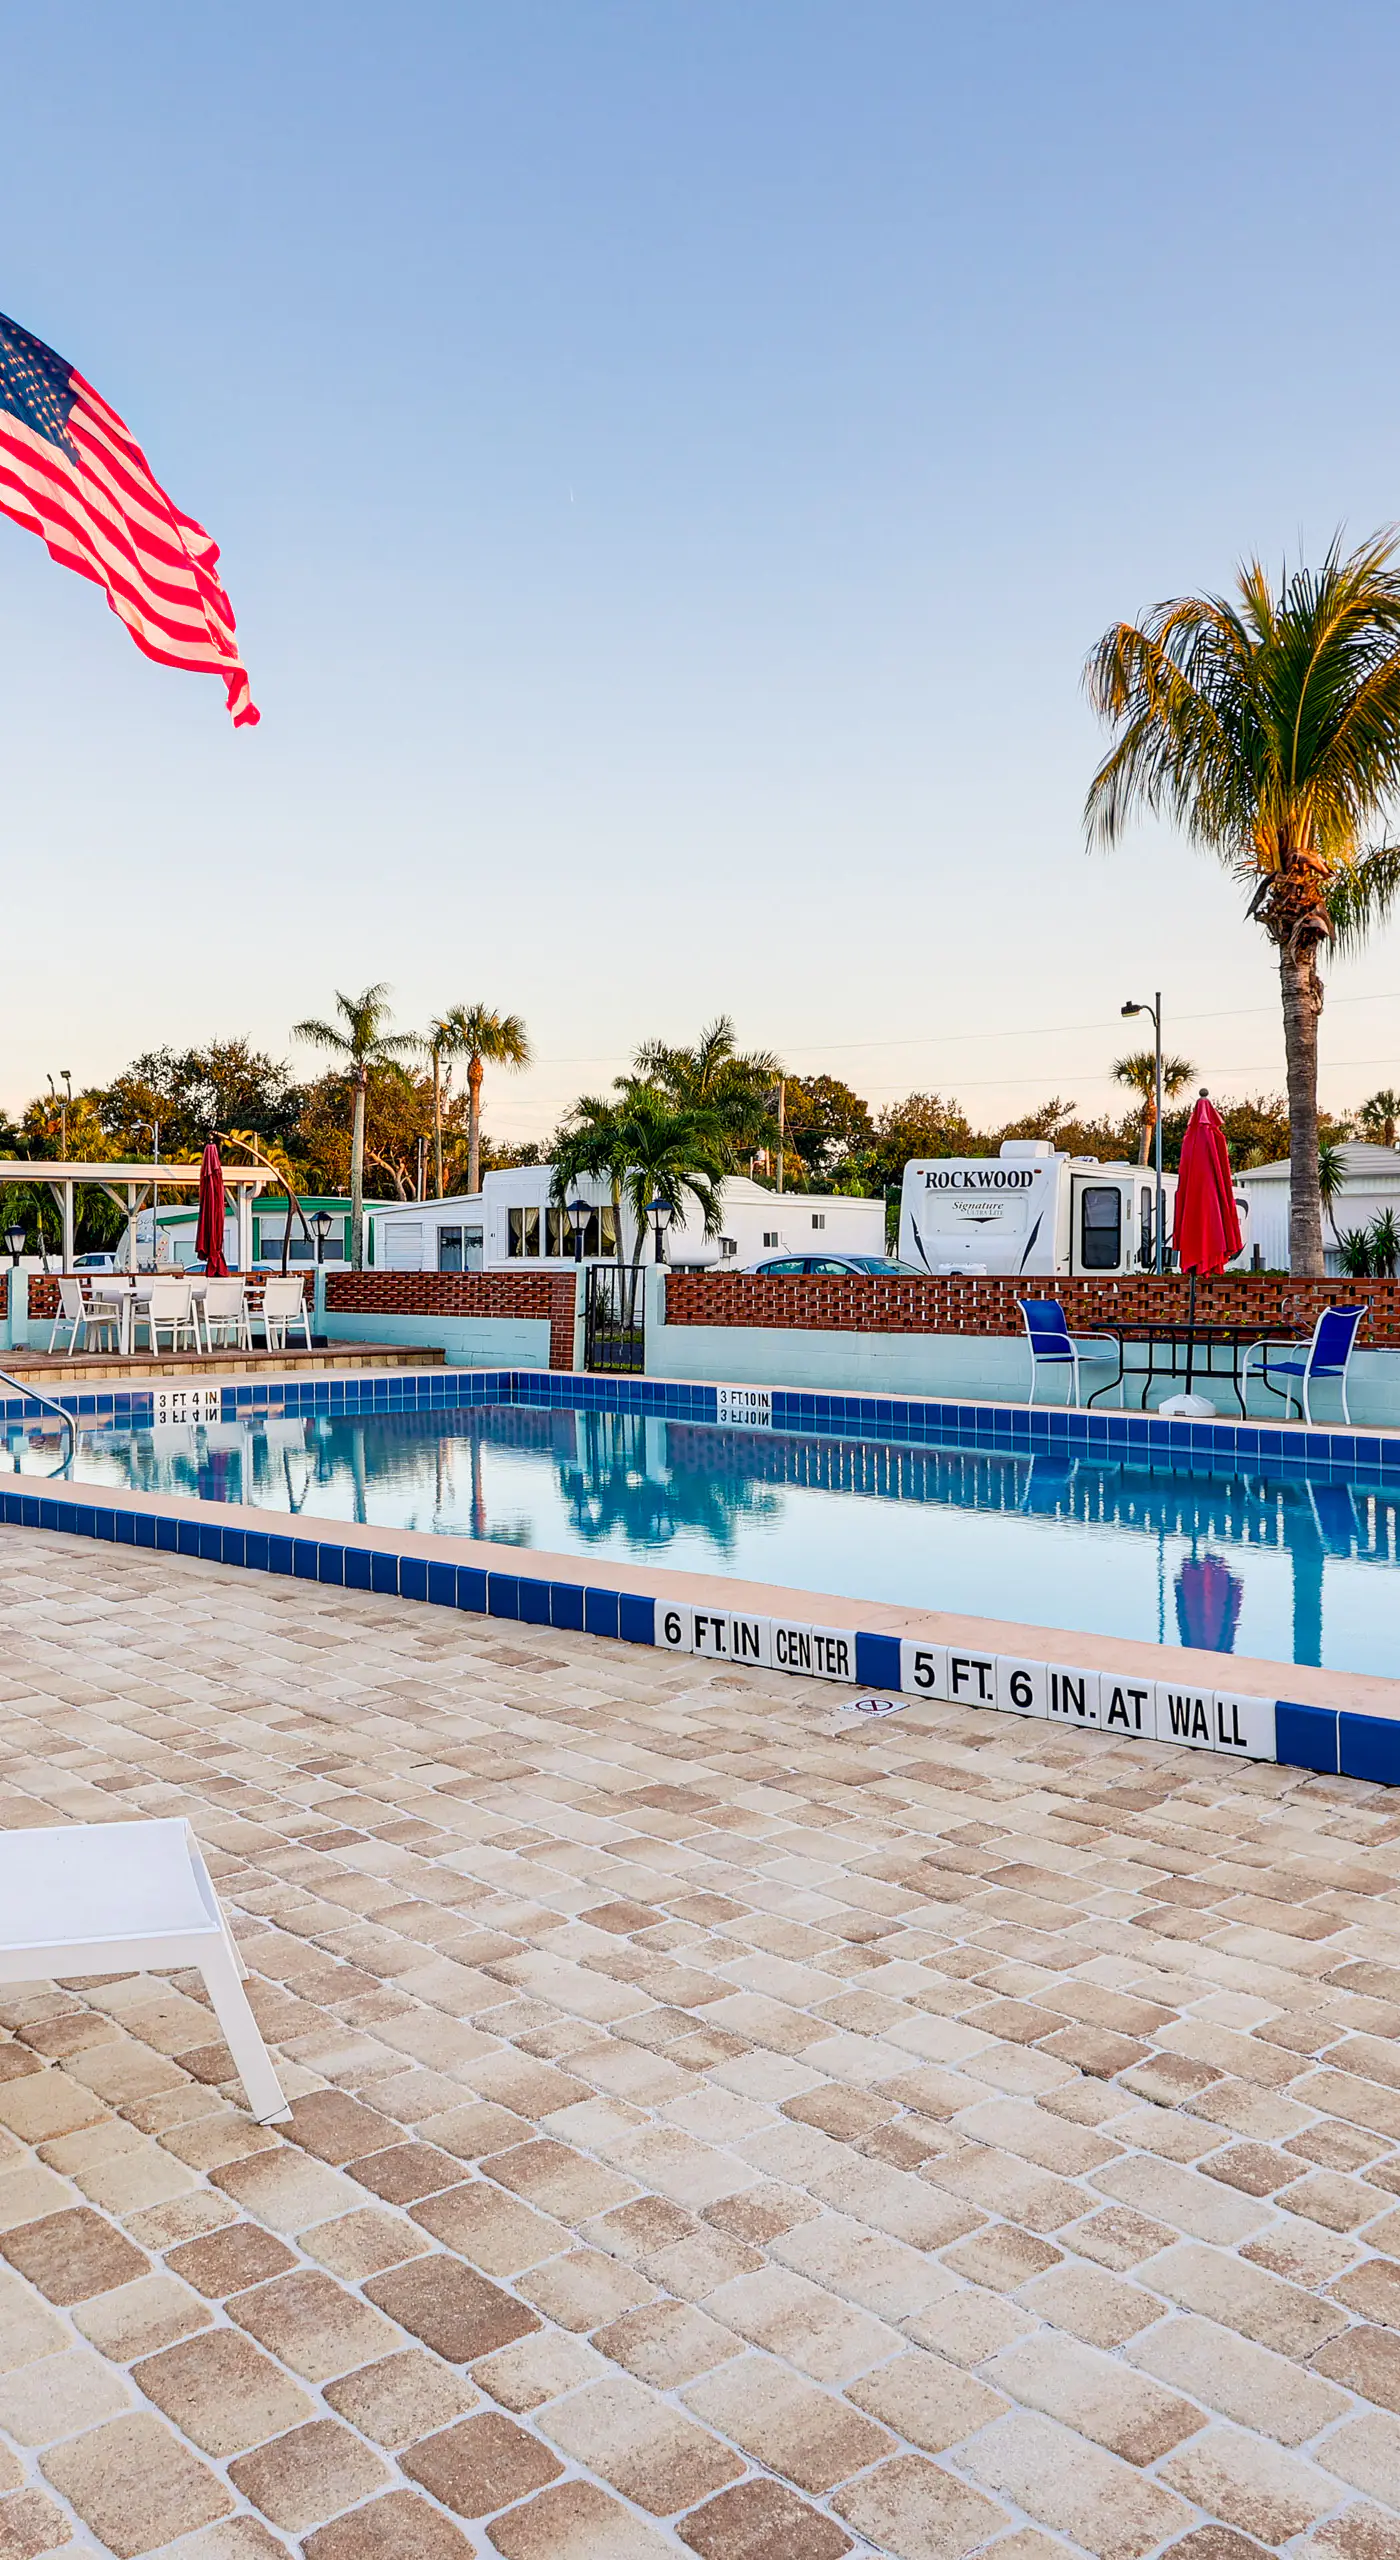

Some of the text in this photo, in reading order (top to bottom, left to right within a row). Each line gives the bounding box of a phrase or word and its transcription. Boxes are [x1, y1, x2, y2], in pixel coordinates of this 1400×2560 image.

[925, 1170, 1034, 1189] ROCKWOOD
[952, 1201, 1004, 1212] Signature
[159, 1390, 220, 1408] 3 FT. 4 IN.
[720, 1390, 727, 1404] 3
[664, 1611, 850, 1676] 6 FT. IN CENTER
[913, 1651, 1248, 1747] 5 FT. 6 IN. AT WALL
